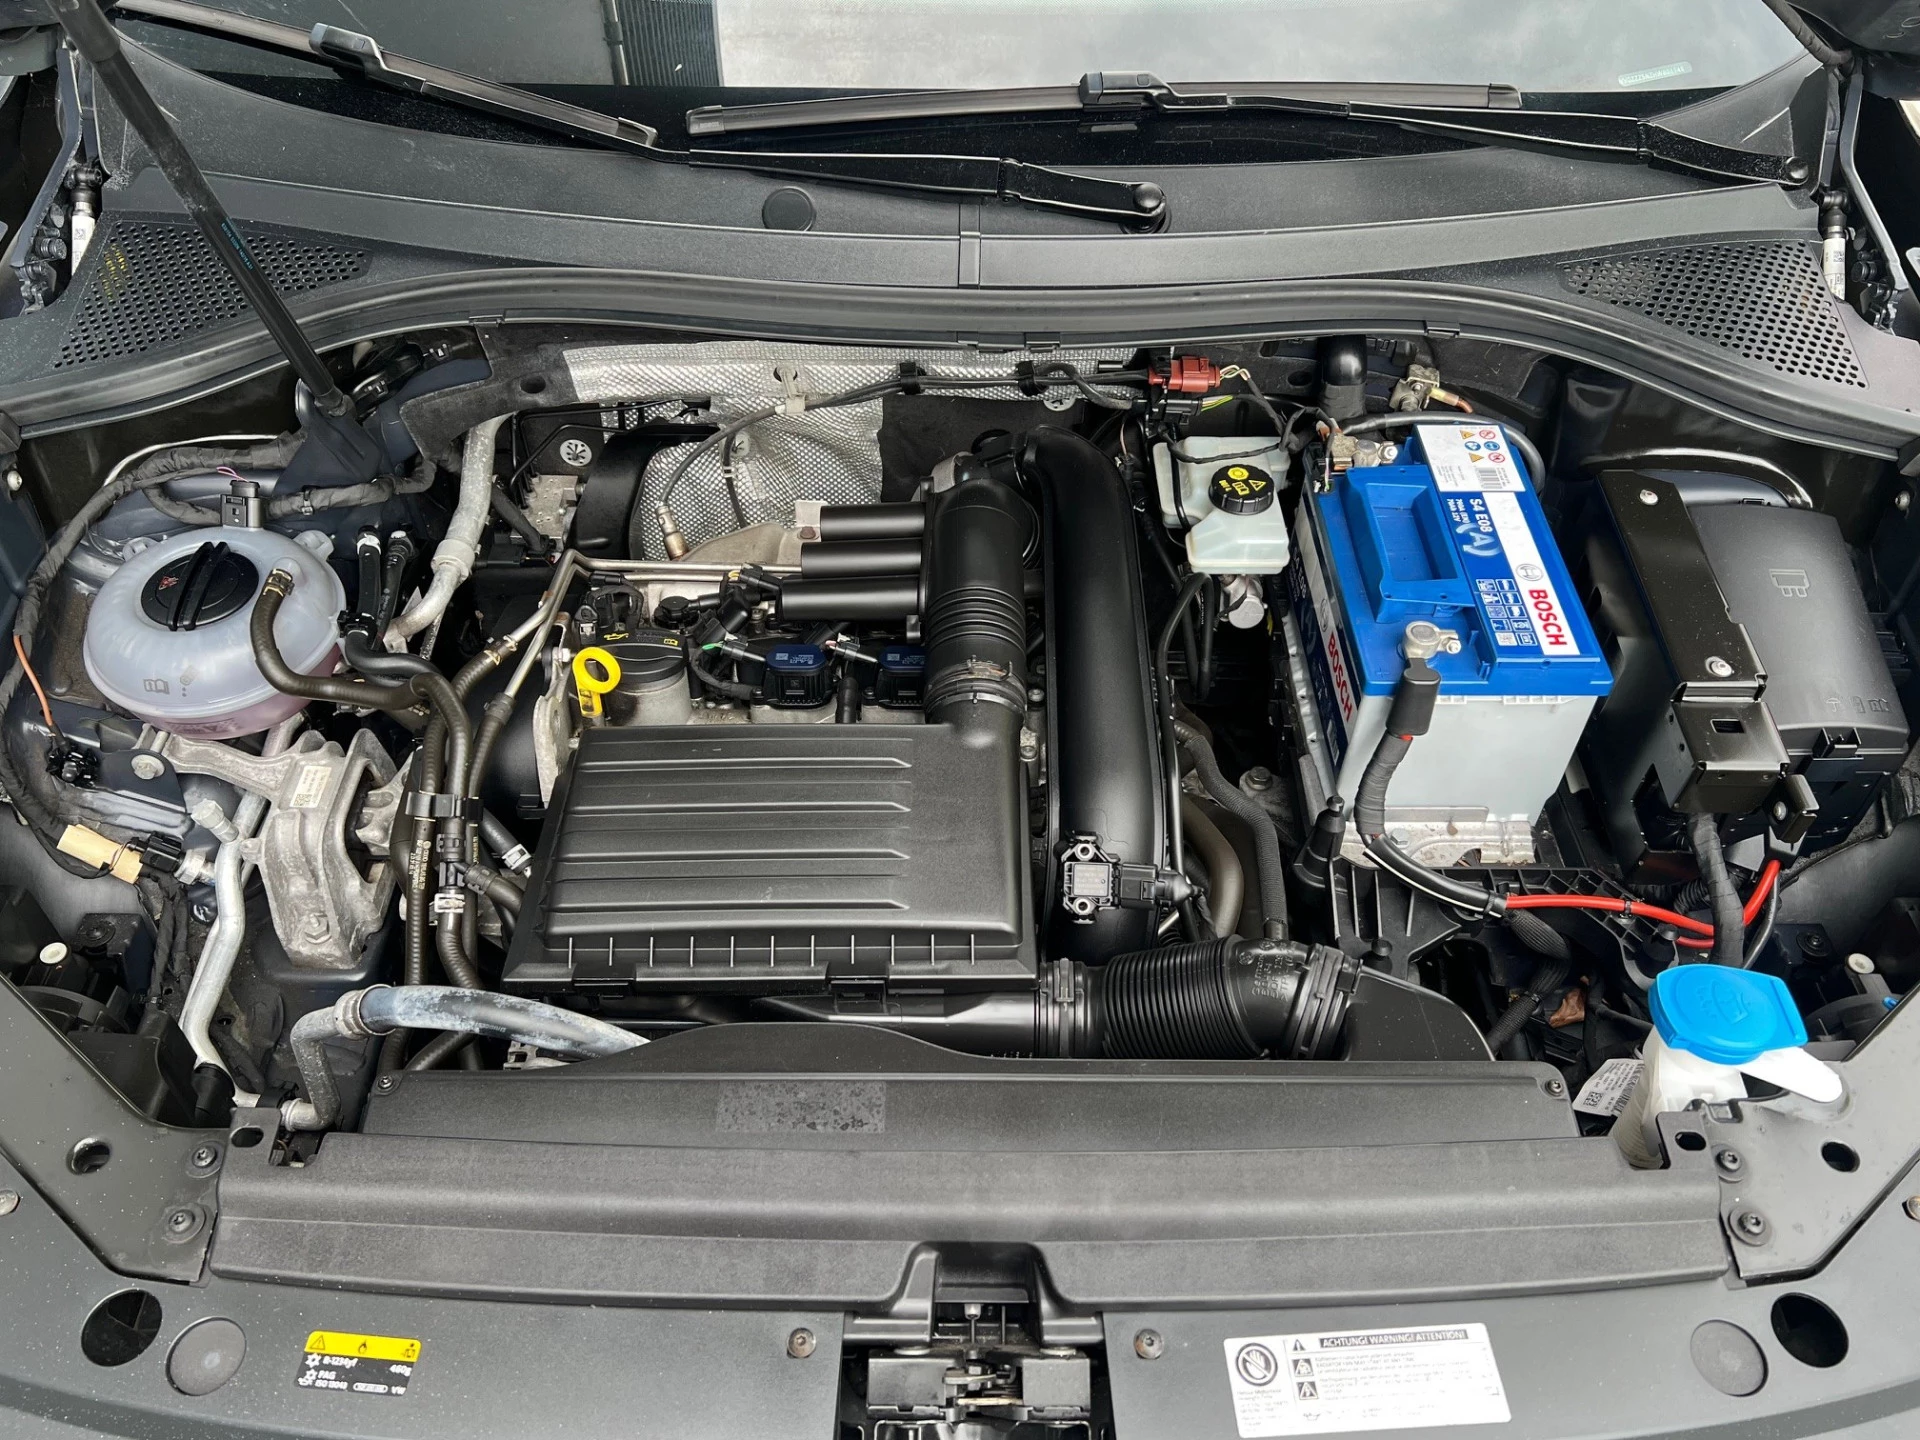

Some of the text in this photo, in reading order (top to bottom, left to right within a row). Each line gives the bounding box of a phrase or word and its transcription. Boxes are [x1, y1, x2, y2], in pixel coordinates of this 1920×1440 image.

[1469, 498, 1494, 532] S4 E08
[1529, 589, 1568, 646] BOSCH
[1328, 633, 1353, 722] BOSCH
[1322, 1330, 1466, 1348] ACHTUNG! WARNING! ATTENTION!
[318, 1370, 337, 1380] PAG
[391, 1386, 406, 1395] VW
